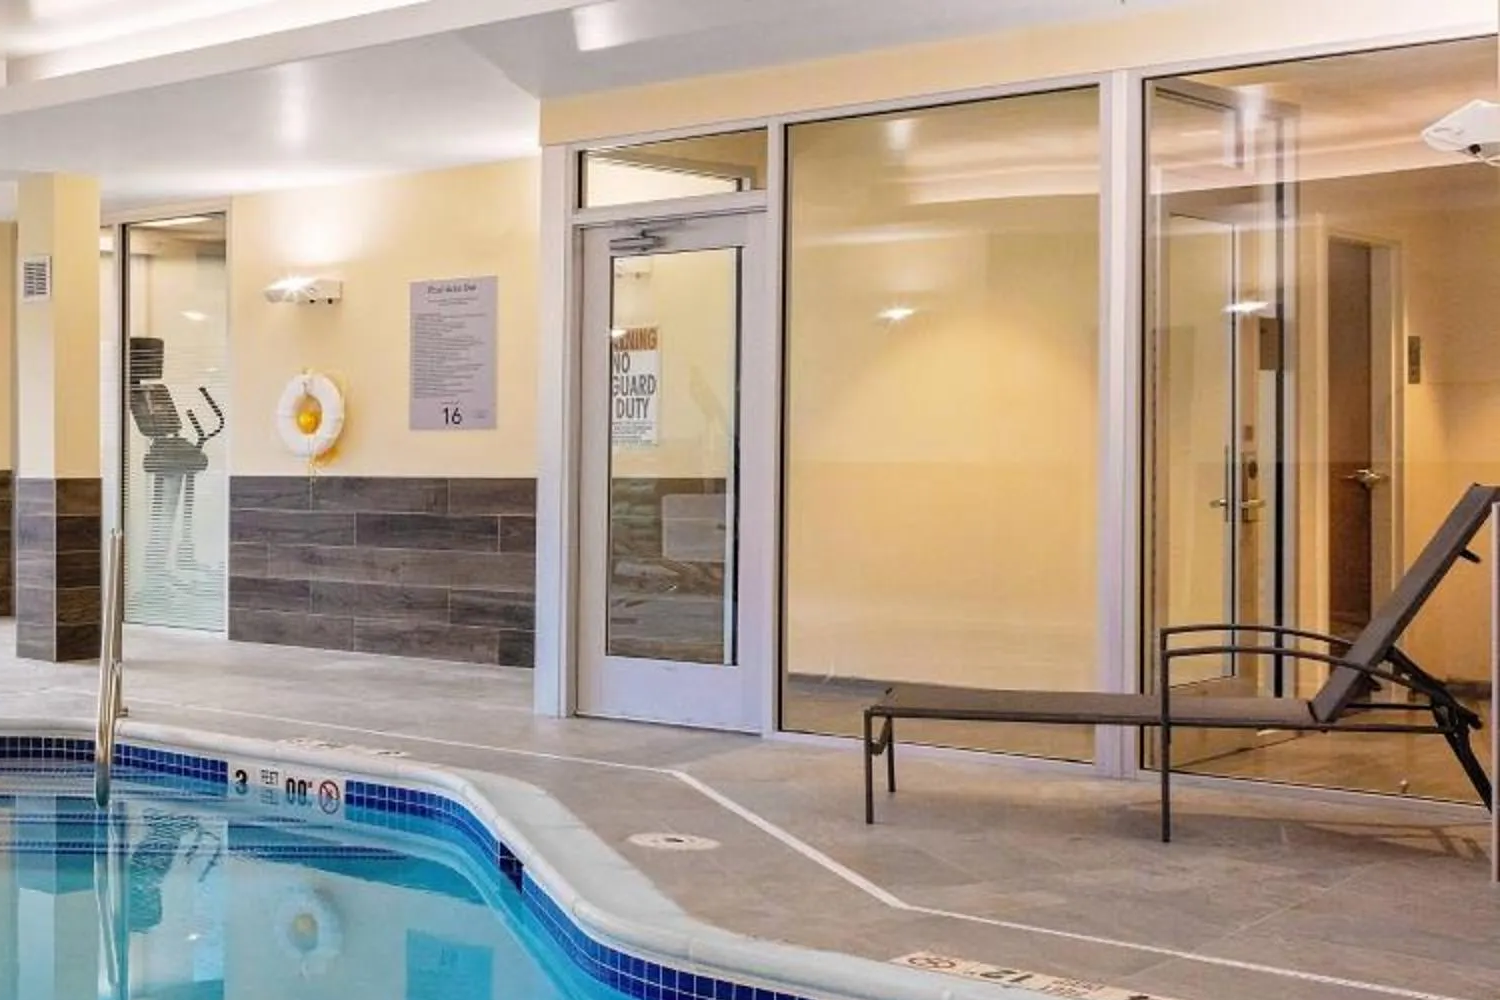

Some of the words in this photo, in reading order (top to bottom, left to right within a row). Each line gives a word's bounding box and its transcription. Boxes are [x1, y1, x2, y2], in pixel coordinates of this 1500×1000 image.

[612, 351, 630, 373] NO
[443, 406, 463, 425] 16
[615, 397, 650, 418] DUTY
